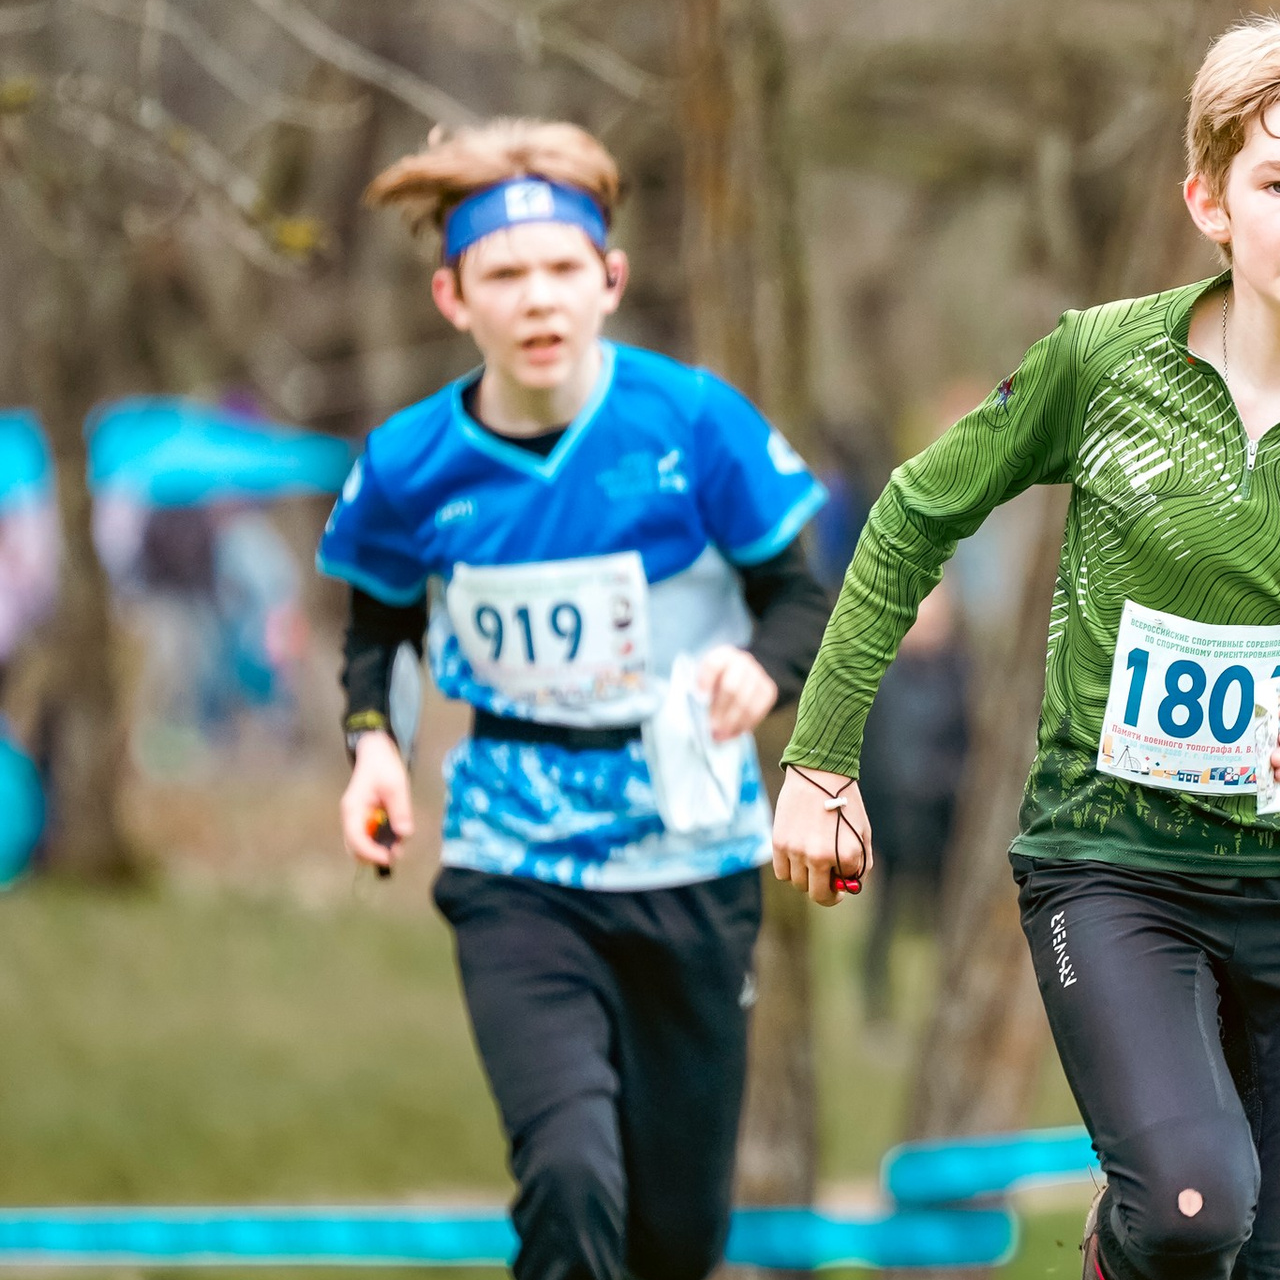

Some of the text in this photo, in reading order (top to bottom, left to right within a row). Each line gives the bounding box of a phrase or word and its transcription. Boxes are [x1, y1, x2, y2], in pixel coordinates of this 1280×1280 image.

[475, 603, 582, 662] 919
[1130, 618, 1190, 643] ВСЕРОССИЙСКИЕ
[1191, 636, 1244, 649] СПОРТИВНЫЕ
[1144, 634, 1155, 644] ПО
[1156, 638, 1212, 658] СПОРТИВНОМУ
[1111, 724, 1142, 741] Памяти
[1143, 735, 1184, 750] военного
[1185, 743, 1233, 755] топографа
[1234, 745, 1243, 754] А.
[1245, 745, 1254, 754] В.
[1050, 910, 1078, 989] ARSWEAR
